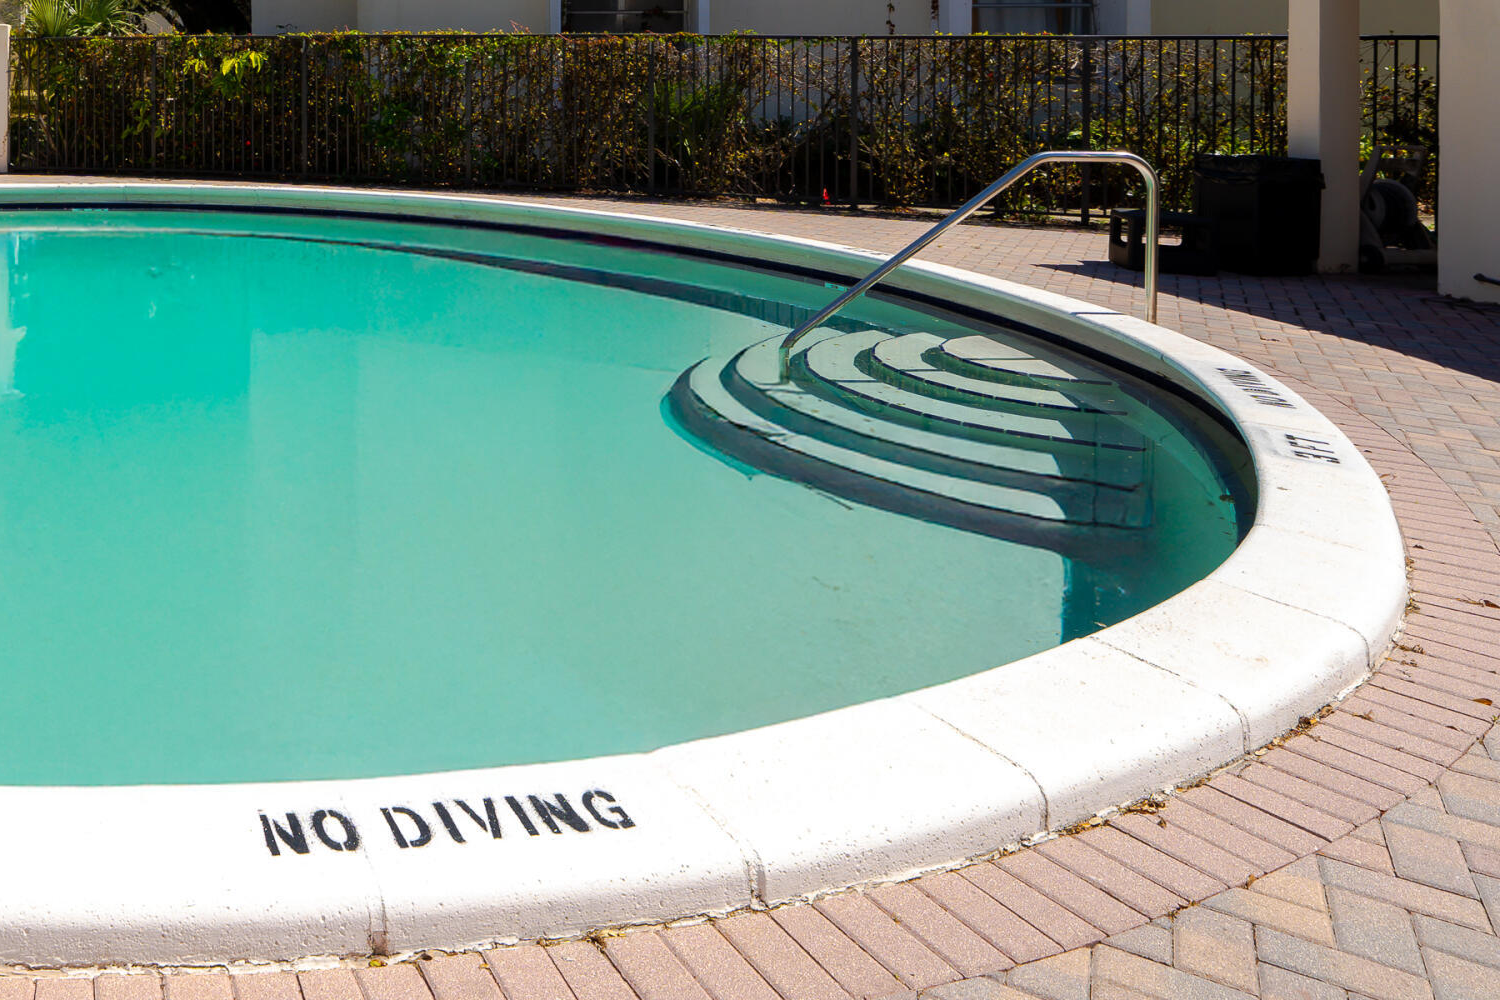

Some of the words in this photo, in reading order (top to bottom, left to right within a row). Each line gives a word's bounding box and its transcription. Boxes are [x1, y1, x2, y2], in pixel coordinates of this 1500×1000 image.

[1284, 433, 1335, 454] FT
[258, 809, 361, 856] NO
[379, 790, 637, 849] DIVING
